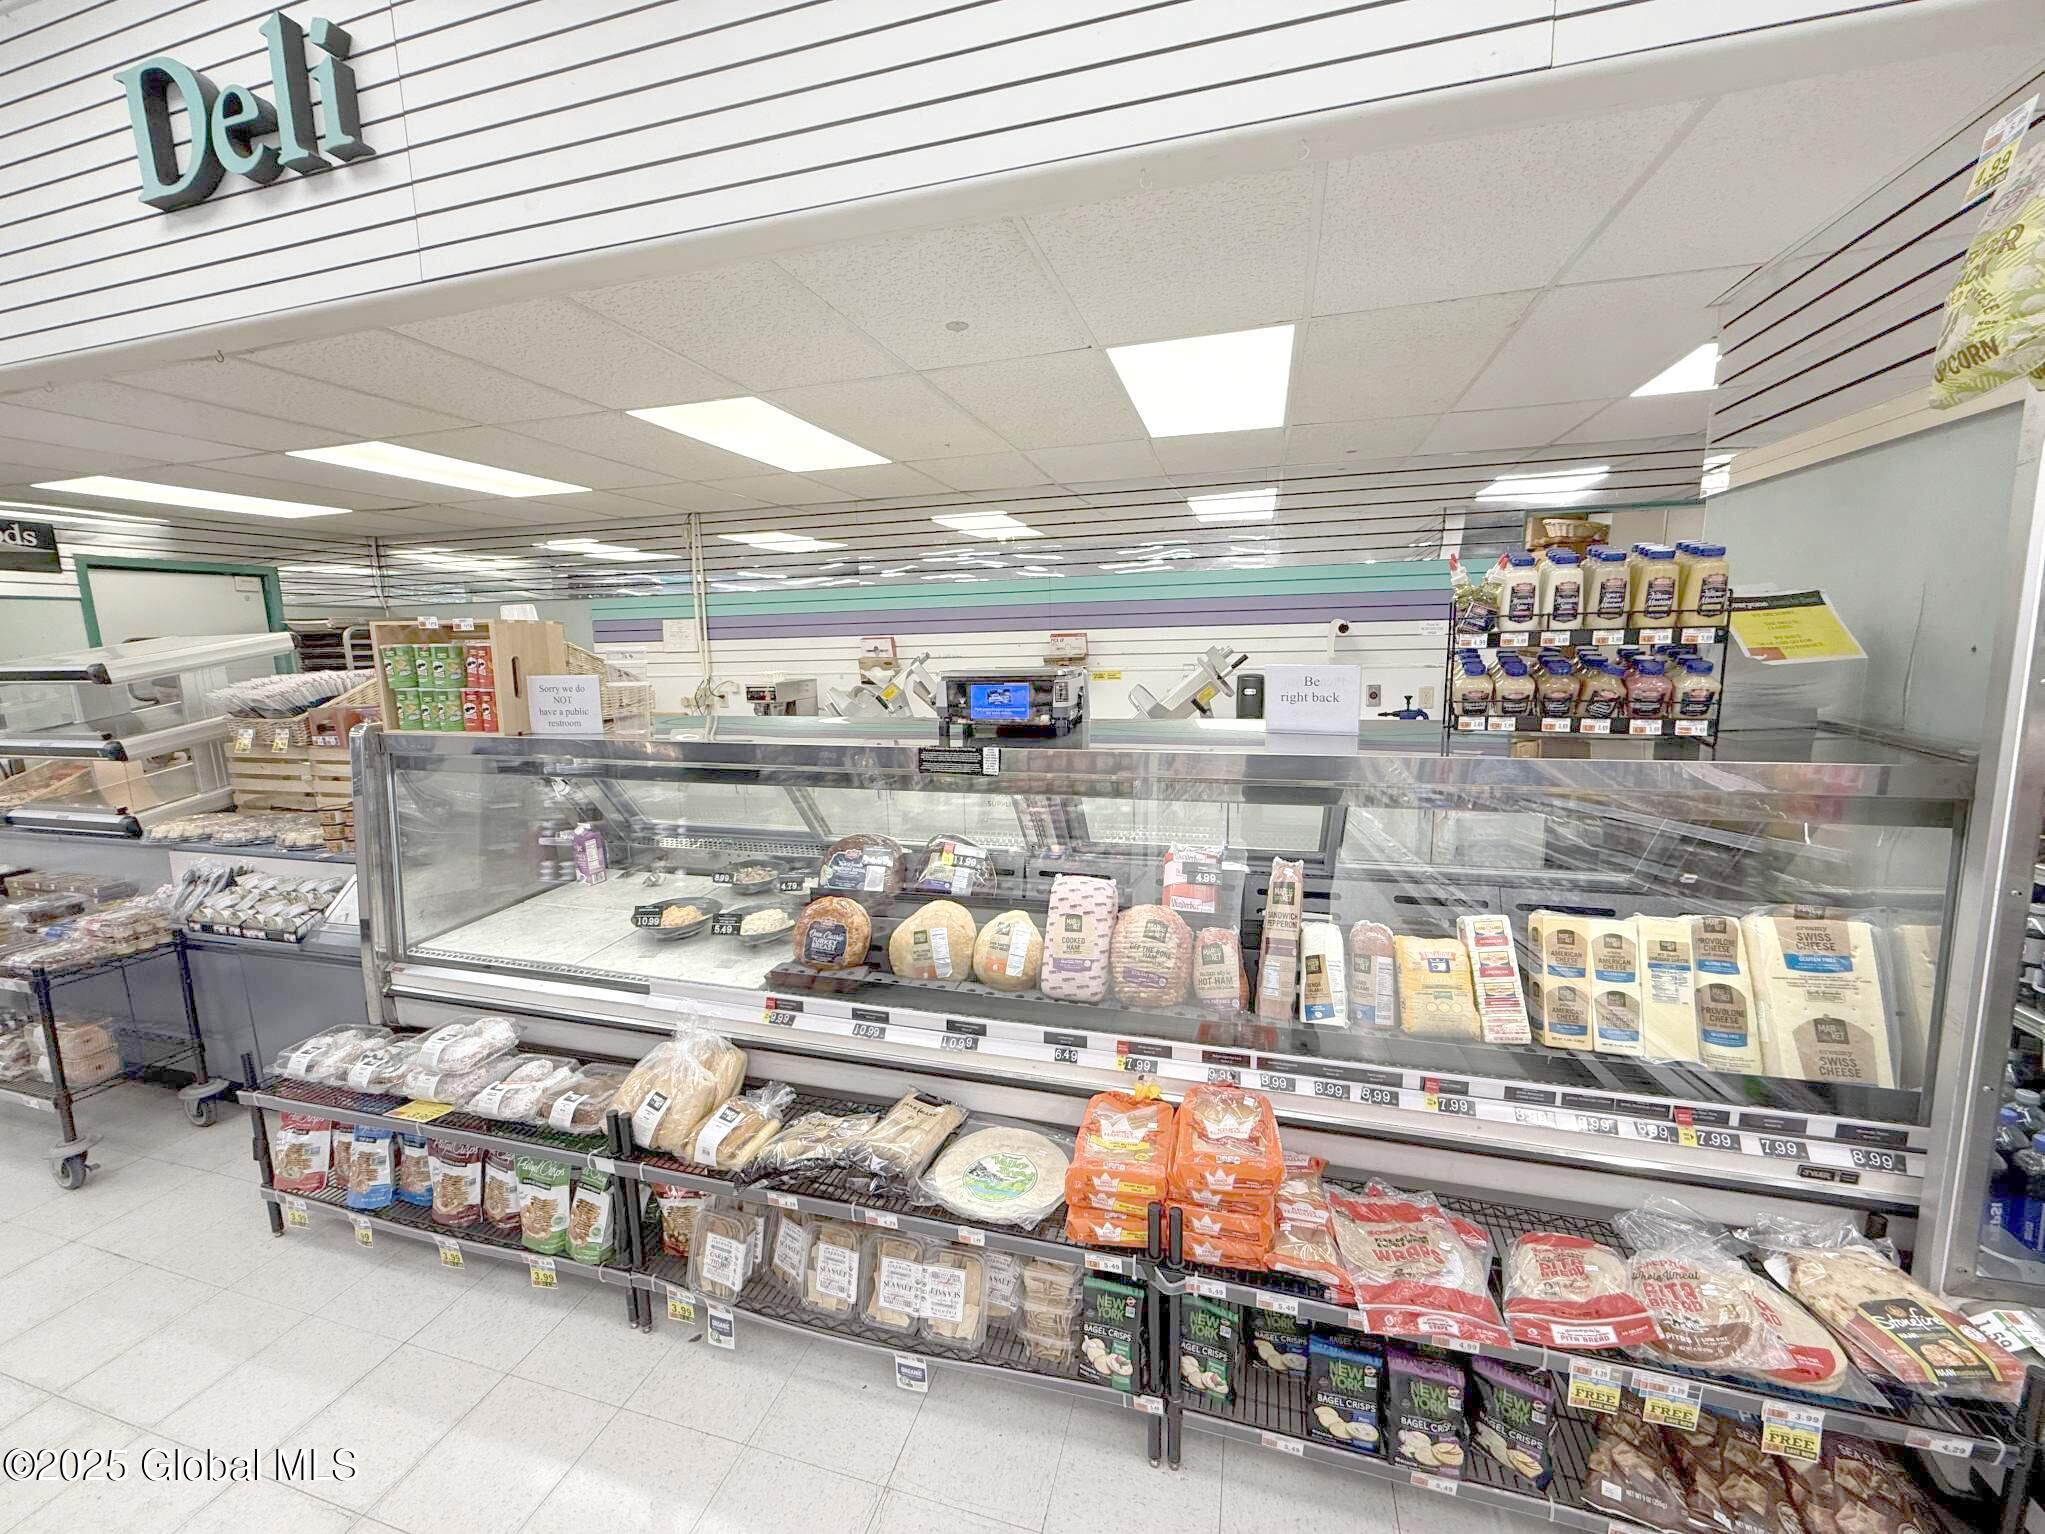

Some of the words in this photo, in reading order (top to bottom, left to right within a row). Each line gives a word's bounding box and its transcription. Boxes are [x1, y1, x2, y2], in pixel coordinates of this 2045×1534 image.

[113, 10, 370, 207] Deli
[1974, 147, 2012, 186] 4.99
[1304, 676, 1320, 686] Be
[539, 684, 561, 695] Sorry
[562, 685, 575, 693] we
[577, 684, 586, 693] do
[553, 696, 572, 704] NOT
[1280, 692, 1308, 704] right
[1312, 692, 1340, 703] back
[539, 708, 557, 717] have
[565, 708, 589, 718] public
[1195, 873, 1217, 883] 4.99
[637, 916, 660, 926] 10.99
[1268, 911, 1298, 921] SANDWICH
[713, 925, 733, 934] 5.49
[1796, 931, 1831, 941] SWISS
[1061, 936, 1086, 944] COOKED
[1796, 942, 1835, 951] CHEESE
[1143, 945, 1154, 953] THE
[1703, 945, 1730, 953] CHEESE
[1215, 977, 1233, 985] HAM
[770, 1013, 790, 1025] 9.99
[1709, 1015, 1739, 1024] CHEESE
[853, 1023, 880, 1038] 10.99
[942, 1036, 973, 1049] 10.99
[1055, 1048, 1078, 1062] 6.49
[1819, 1057, 1857, 1067] SWISS
[1126, 1057, 1151, 1072] 7.99
[1819, 1066, 1862, 1078] CHEESE
[1260, 1073, 1287, 1089] 8.99
[1315, 1081, 1342, 1097] 8.99
[1361, 1087, 1390, 1103] 8.99
[1439, 1098, 1468, 1112] 7.99
[1697, 1131, 1731, 1147] 7.99
[1761, 1139, 1797, 1155] 7.99
[1853, 1149, 1893, 1168] 8.99
[540, 1158, 566, 1177] Crisps
[442, 1251, 461, 1263] 3.99
[1372, 1245, 1445, 1264] WRAPS
[1540, 1258, 1584, 1273] PITA
[534, 1271, 554, 1282] 3.99
[1643, 1281, 1698, 1300] PITA
[1097, 1293, 1125, 1309] NEW
[1649, 1298, 1703, 1312] BREAD
[671, 1303, 692, 1317] 3.99
[1097, 1305, 1124, 1321] YORK
[711, 1317, 731, 1329] ORGANIC
[1190, 1311, 1219, 1328] NEW
[1872, 1307, 1944, 1331] Stonefire
[1084, 1323, 1107, 1336] BAGEL
[1108, 1329, 1132, 1342] CRISPS
[1190, 1323, 1218, 1340] YORK
[1181, 1341, 1200, 1354] AGEL
[1201, 1346, 1228, 1361] CRISPS
[901, 1366, 923, 1377] ORGANIC
[1329, 1360, 1363, 1380] NEW
[1935, 1368, 1957, 1377] NAAN
[1330, 1375, 1364, 1393] YORK
[1410, 1381, 1446, 1401] NEW
[1317, 1394, 1344, 1407] BAGEL
[1346, 1398, 1376, 1413] CRISPS
[1494, 1387, 1531, 1410] NEW
[1575, 1388, 1617, 1405] FREE
[1411, 1395, 1448, 1416] YORK
[1621, 1400, 1641, 1416] SEA
[1650, 1405, 1693, 1420] FREE
[1401, 1416, 1429, 1431] BAGEL
[1794, 1413, 1820, 1424] 3.99
[1508, 1431, 1544, 1450] CRISPS
[1736, 1427, 1760, 1447] SEA
[1769, 1432, 1815, 1451] FREE
[1838, 1443, 1864, 1461] SEA
